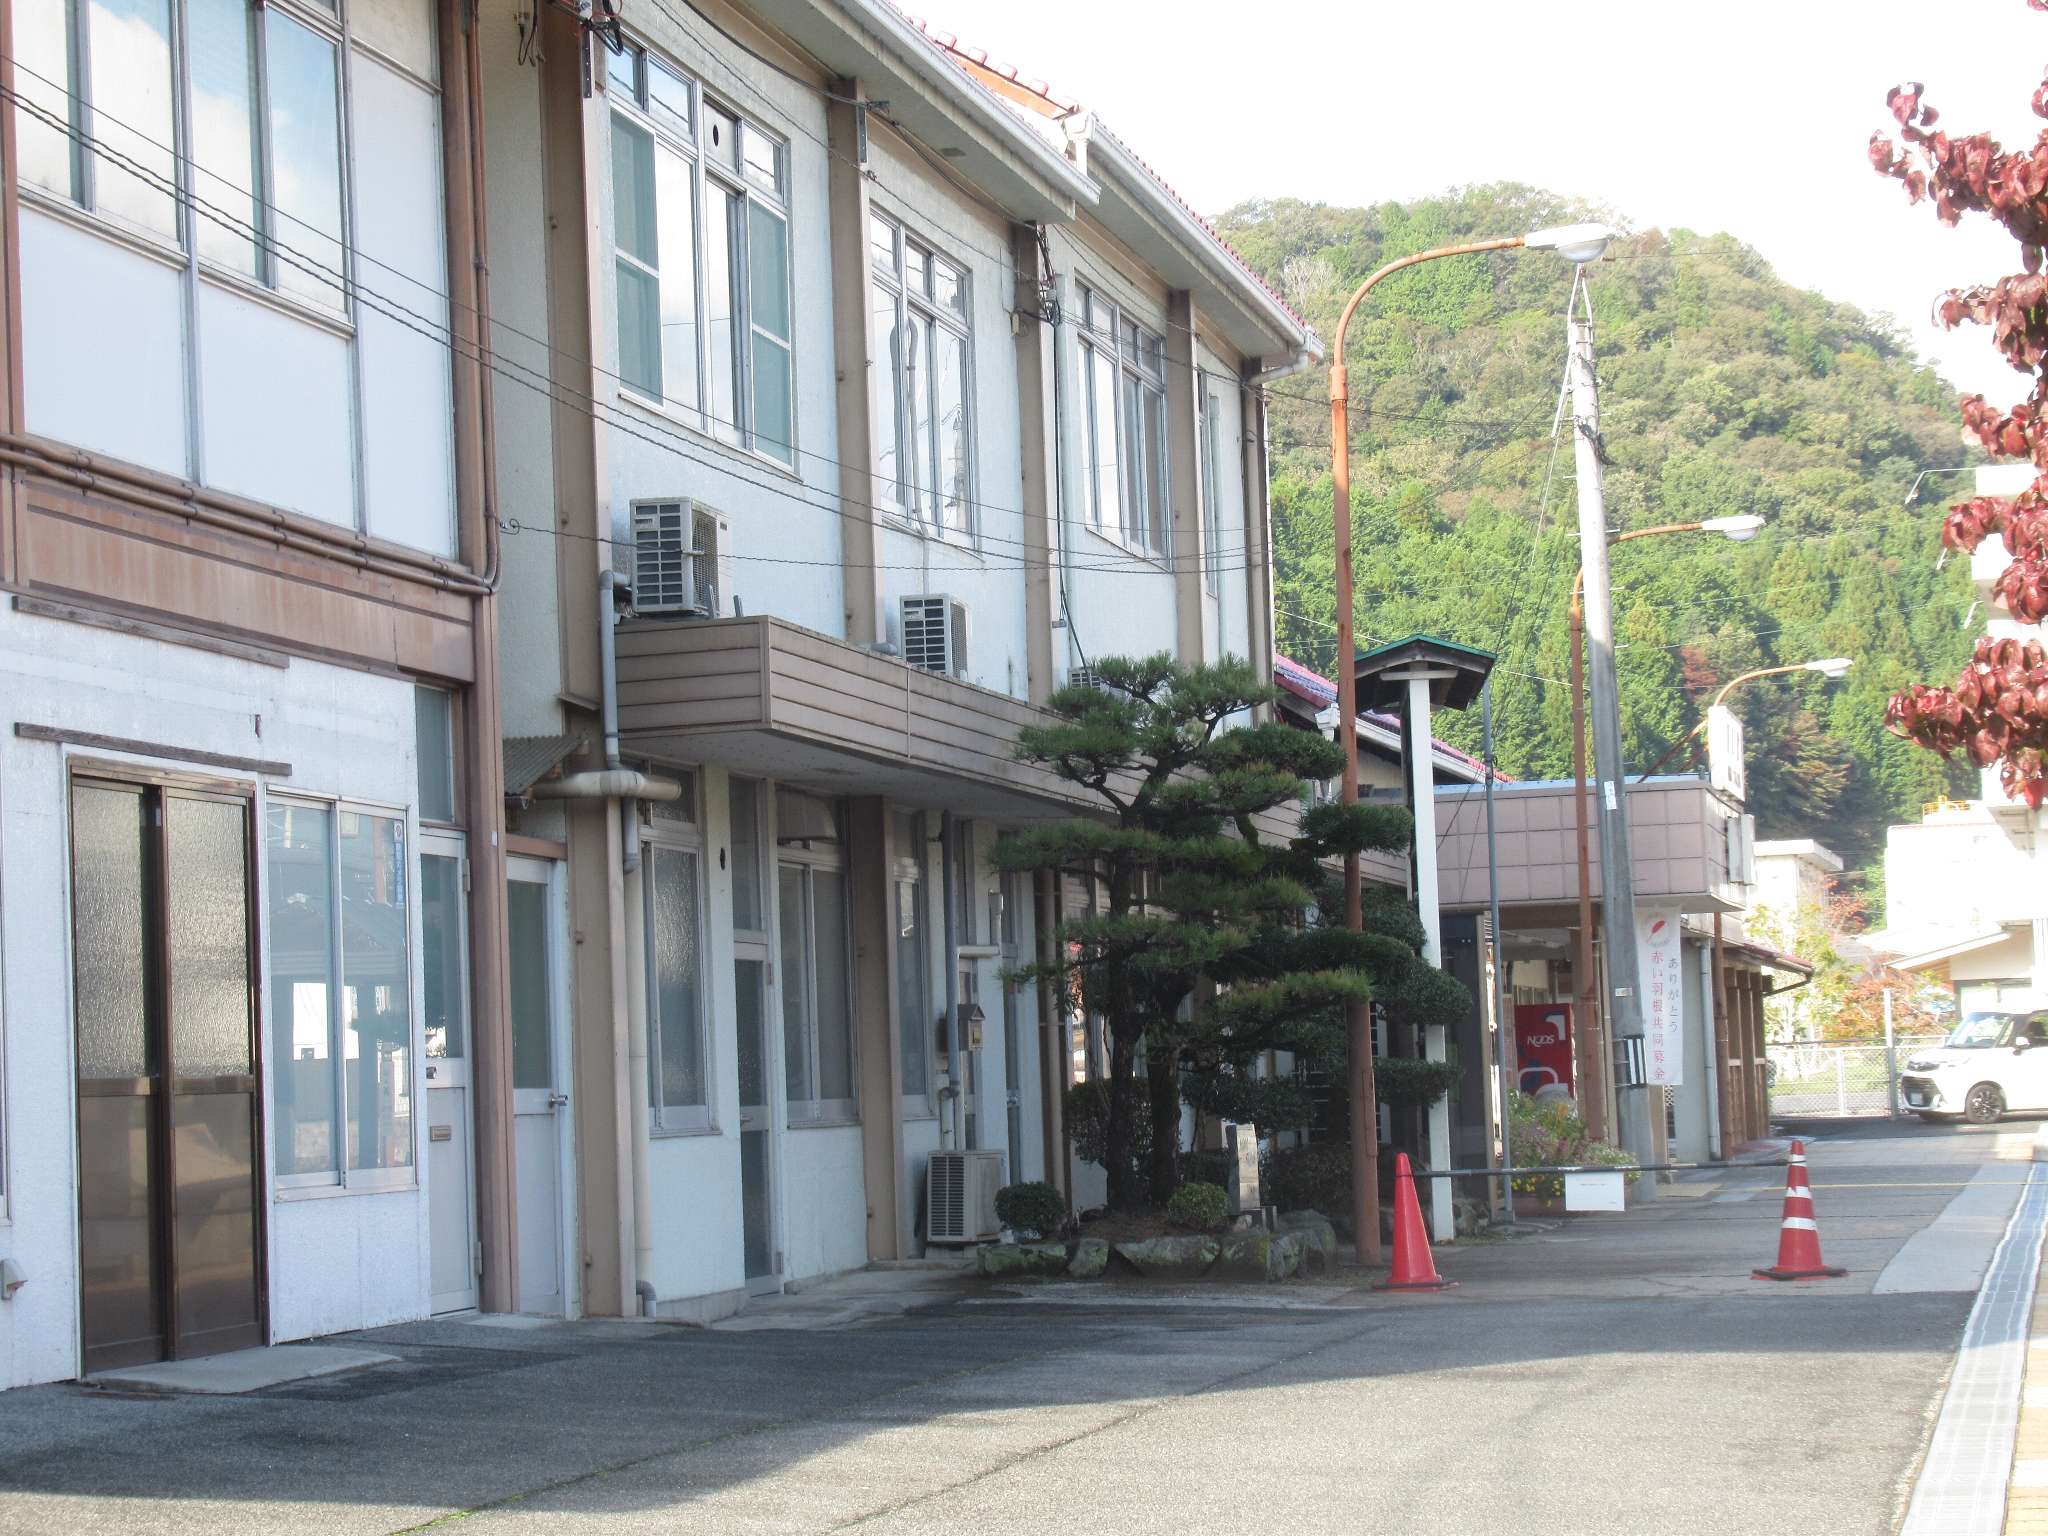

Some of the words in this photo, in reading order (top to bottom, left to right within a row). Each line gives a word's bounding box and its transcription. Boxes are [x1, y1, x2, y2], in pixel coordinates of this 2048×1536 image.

[1667, 957, 1680, 1032] ありがとう
